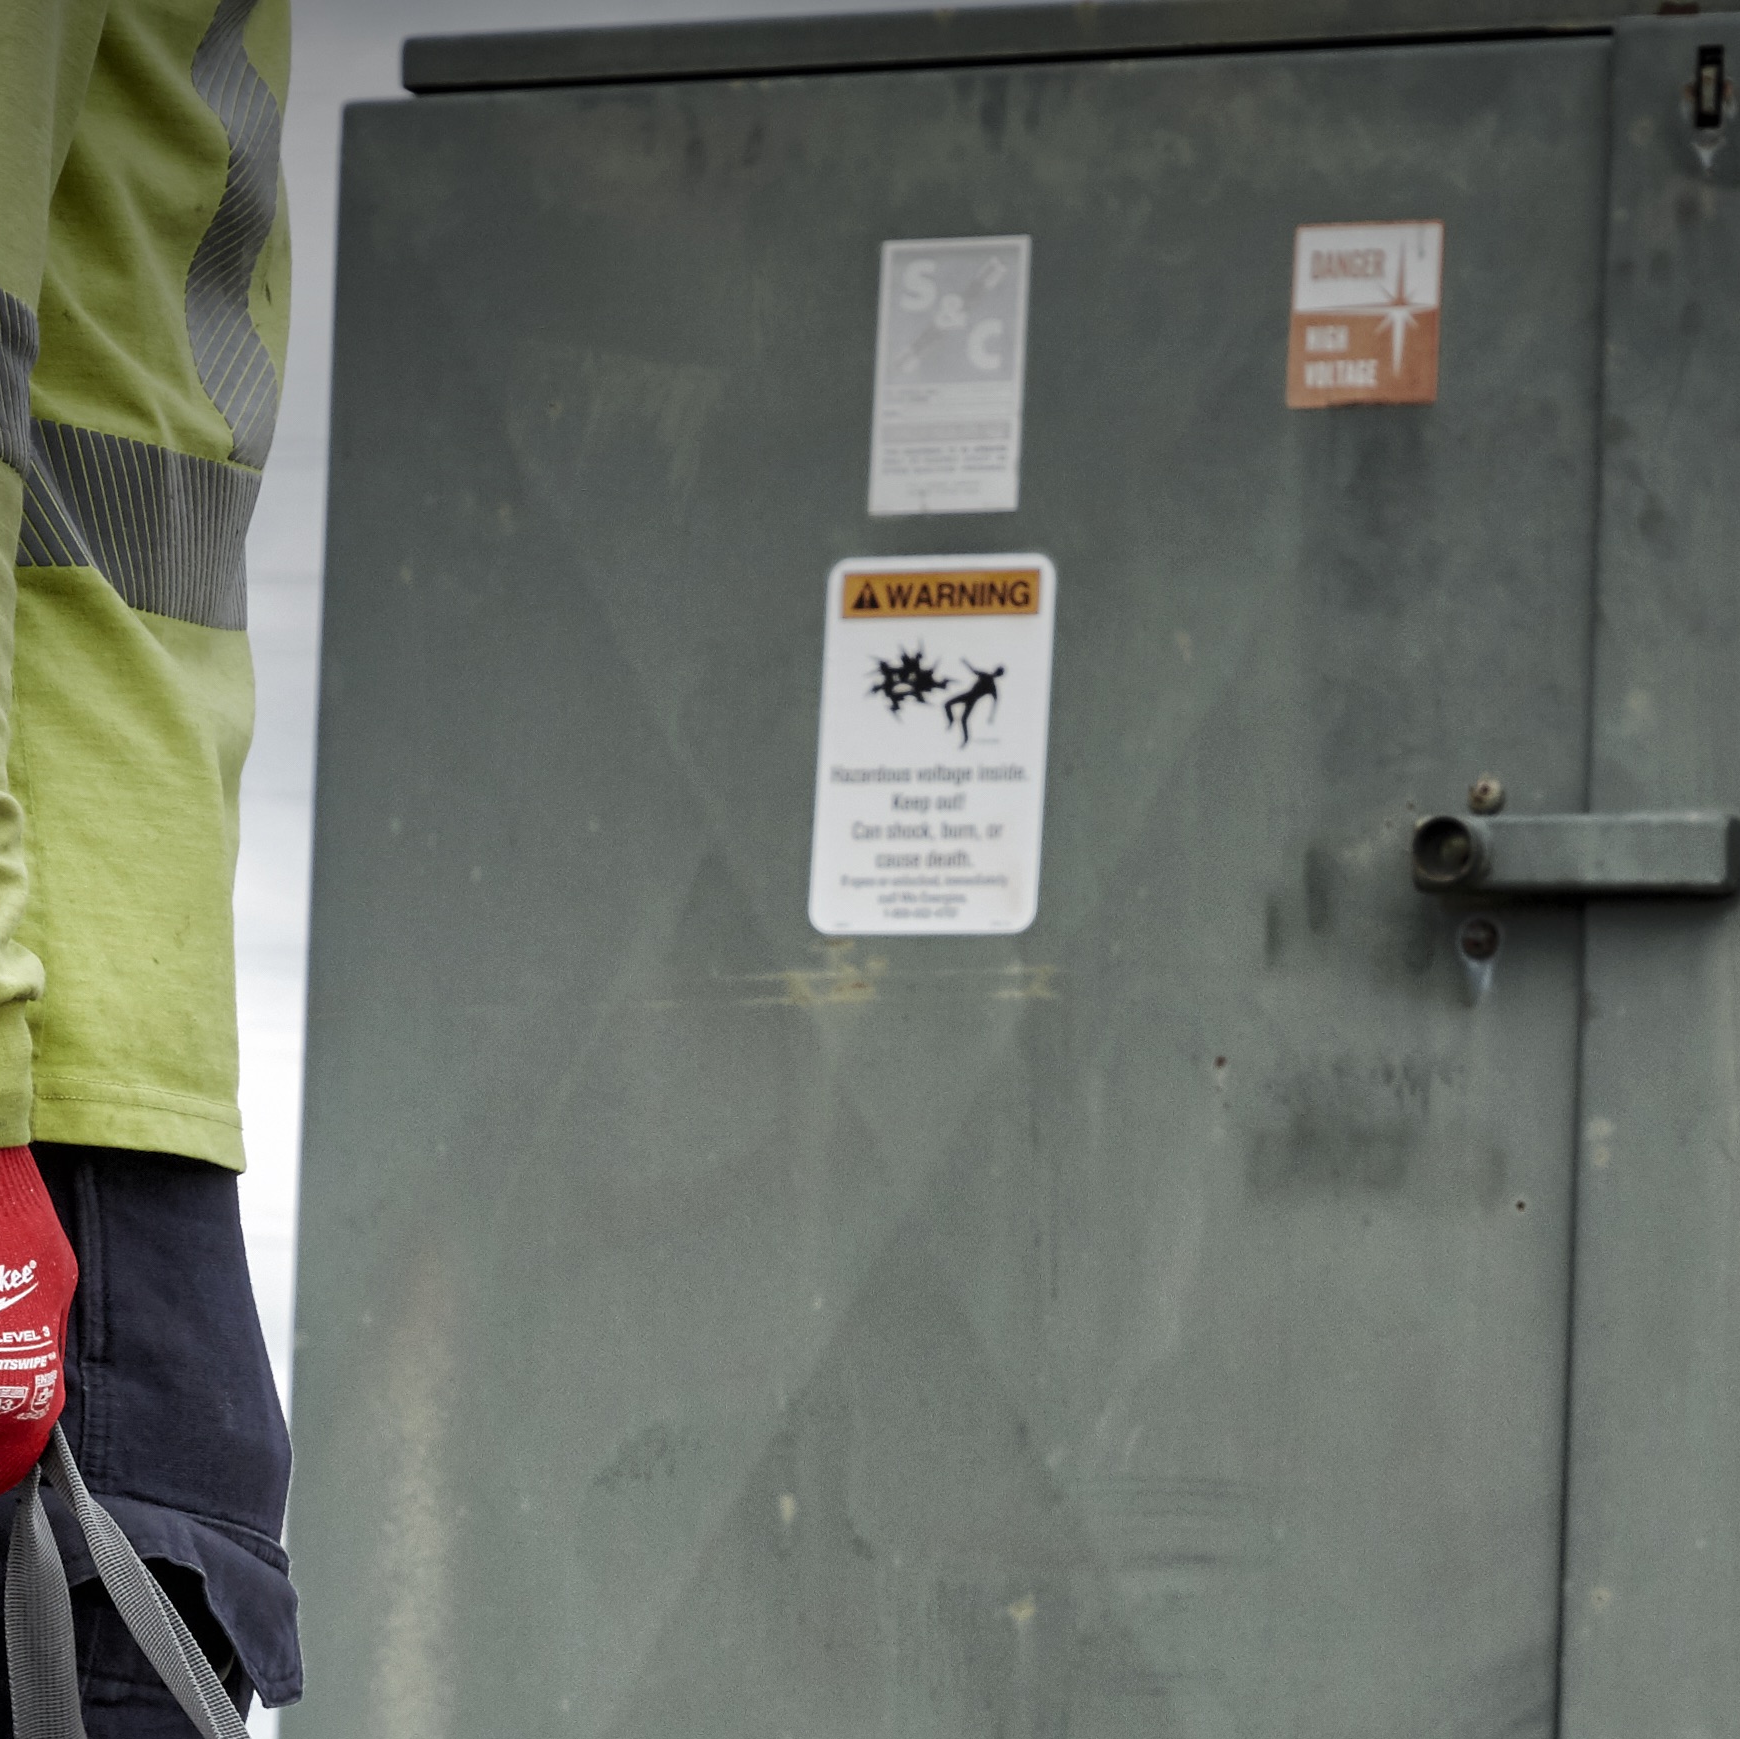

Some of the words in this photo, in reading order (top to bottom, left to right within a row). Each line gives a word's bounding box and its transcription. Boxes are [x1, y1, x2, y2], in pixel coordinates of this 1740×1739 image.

[1311, 249, 1385, 280] DANGER
[1305, 325, 1349, 352] HIGH
[1305, 358, 1378, 389] VOLTAGE
[886, 580, 1030, 609] WARNING
[851, 821, 881, 840] Can
[986, 823, 1003, 839] or
[43, 1326, 50, 1337] 3
